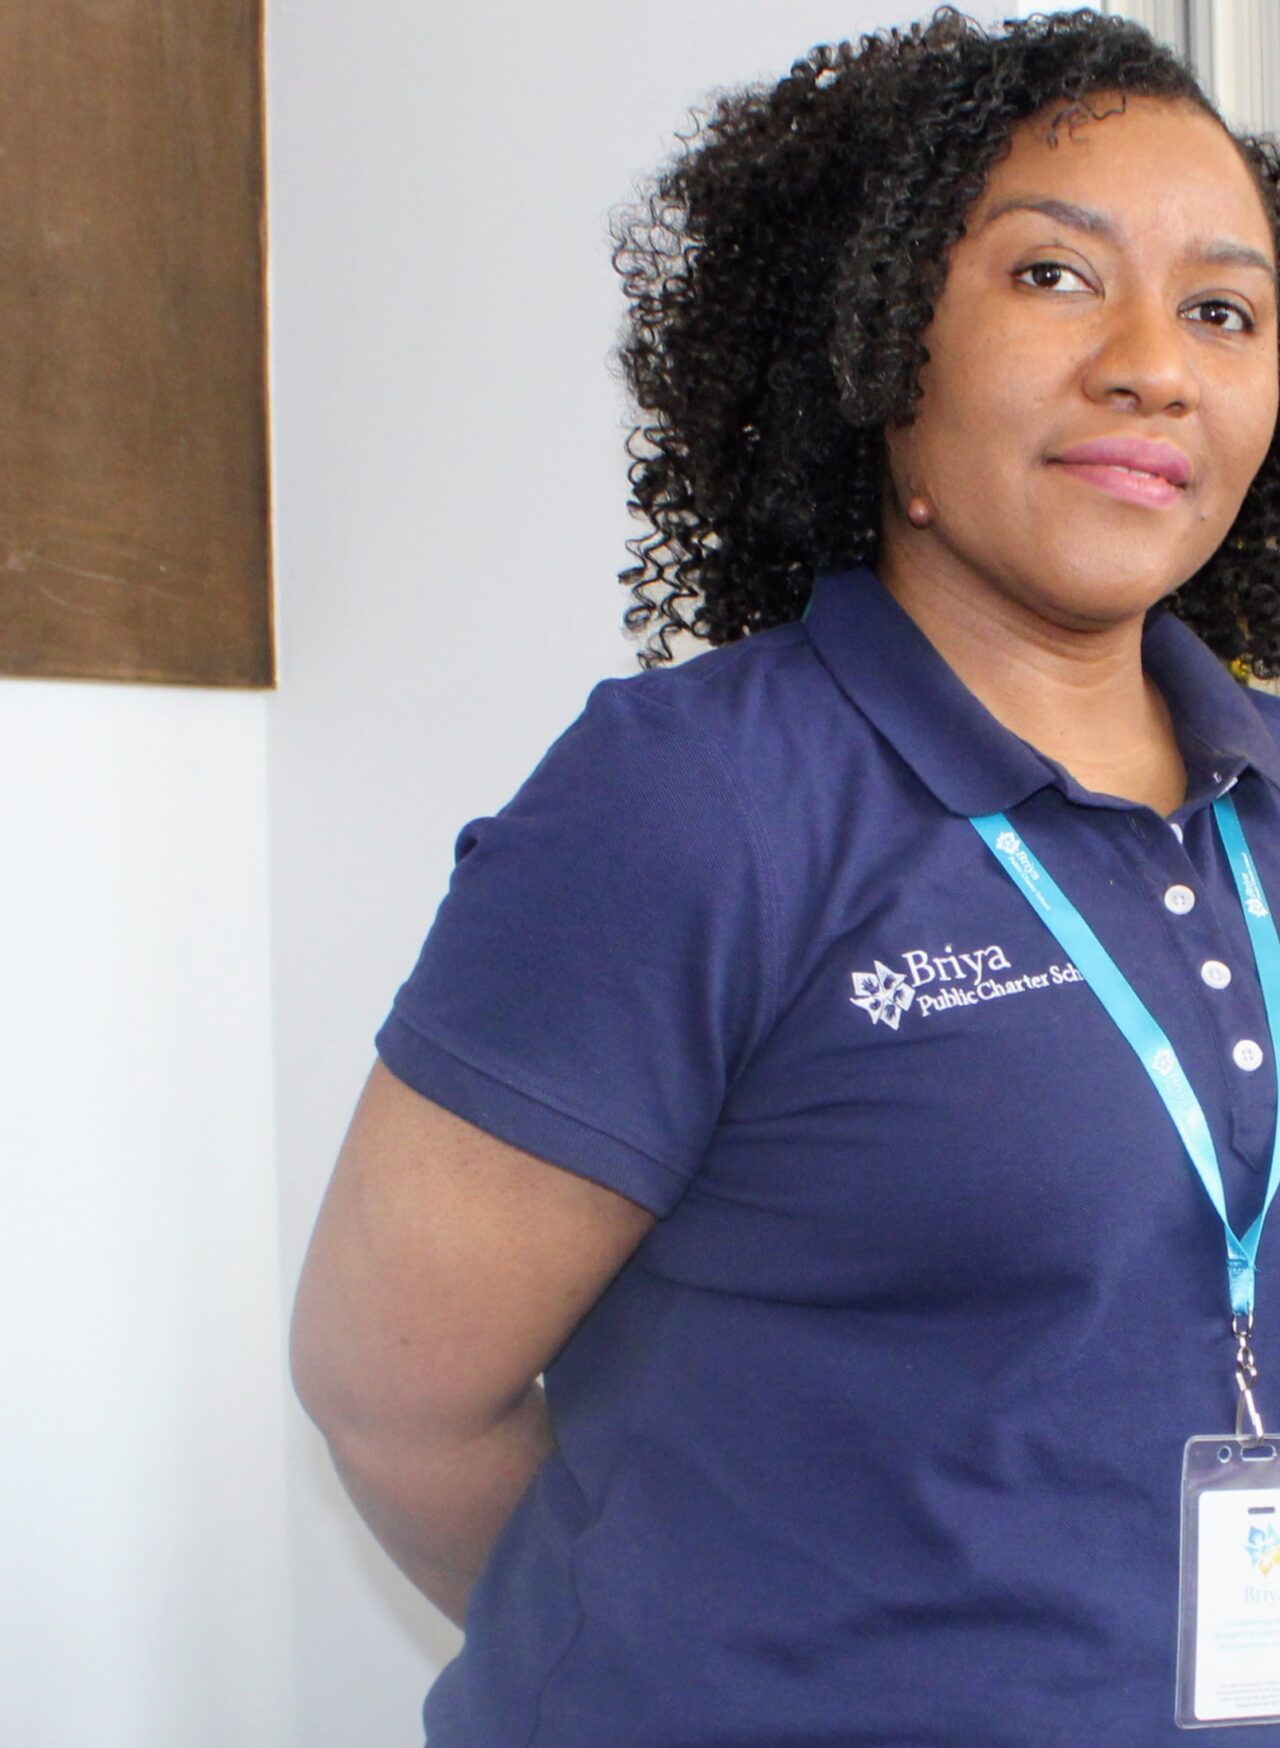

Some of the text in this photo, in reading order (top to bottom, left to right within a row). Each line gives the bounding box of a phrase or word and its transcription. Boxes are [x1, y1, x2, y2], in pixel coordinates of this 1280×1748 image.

[902, 943, 1012, 988] Briya
[917, 962, 1085, 1017] Public Charter Sch
